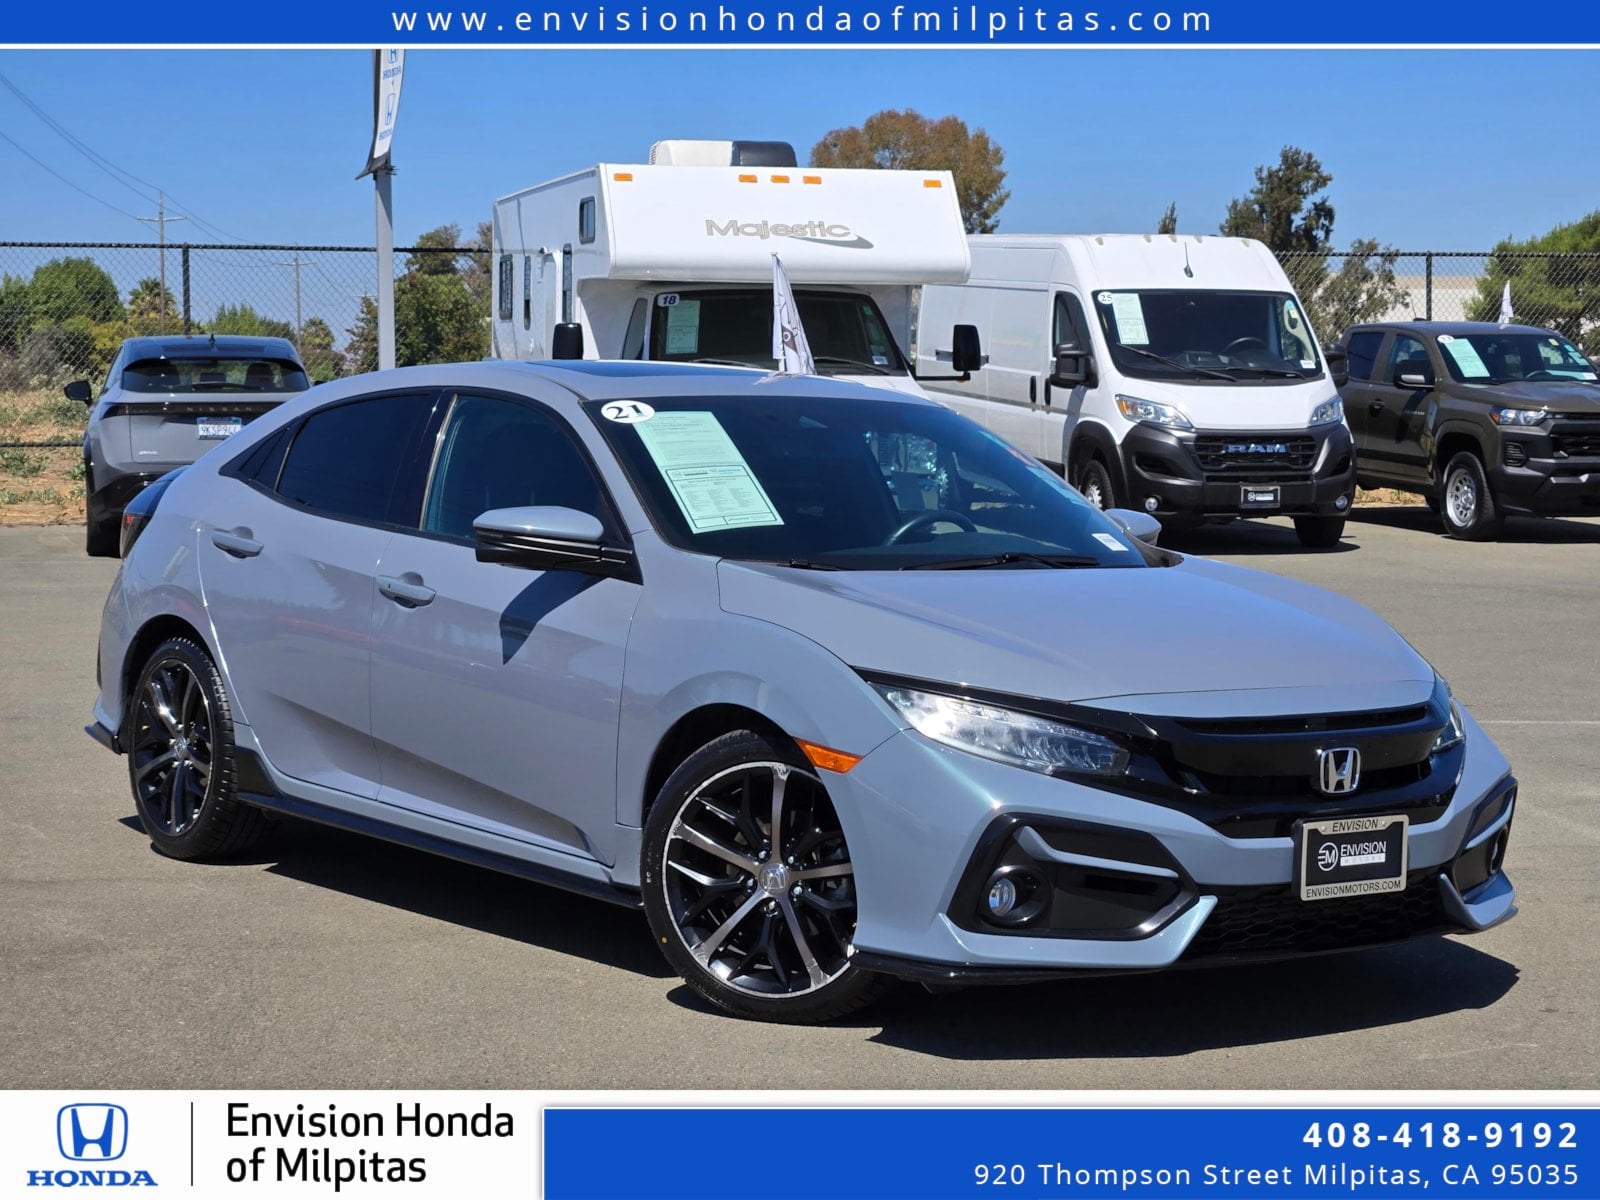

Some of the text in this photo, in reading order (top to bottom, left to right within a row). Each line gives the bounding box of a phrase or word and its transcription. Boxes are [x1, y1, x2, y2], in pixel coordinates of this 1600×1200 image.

[705, 219, 851, 240] Majestic
[662, 295, 677, 305] 18
[1100, 294, 1113, 302] 25
[606, 404, 644, 419] 21
[1228, 444, 1286, 453] RAM
[1332, 818, 1379, 832] ENVISION
[1340, 841, 1387, 857] ENVISION
[1306, 879, 1401, 898] ENVISIONMOTORS.COM
